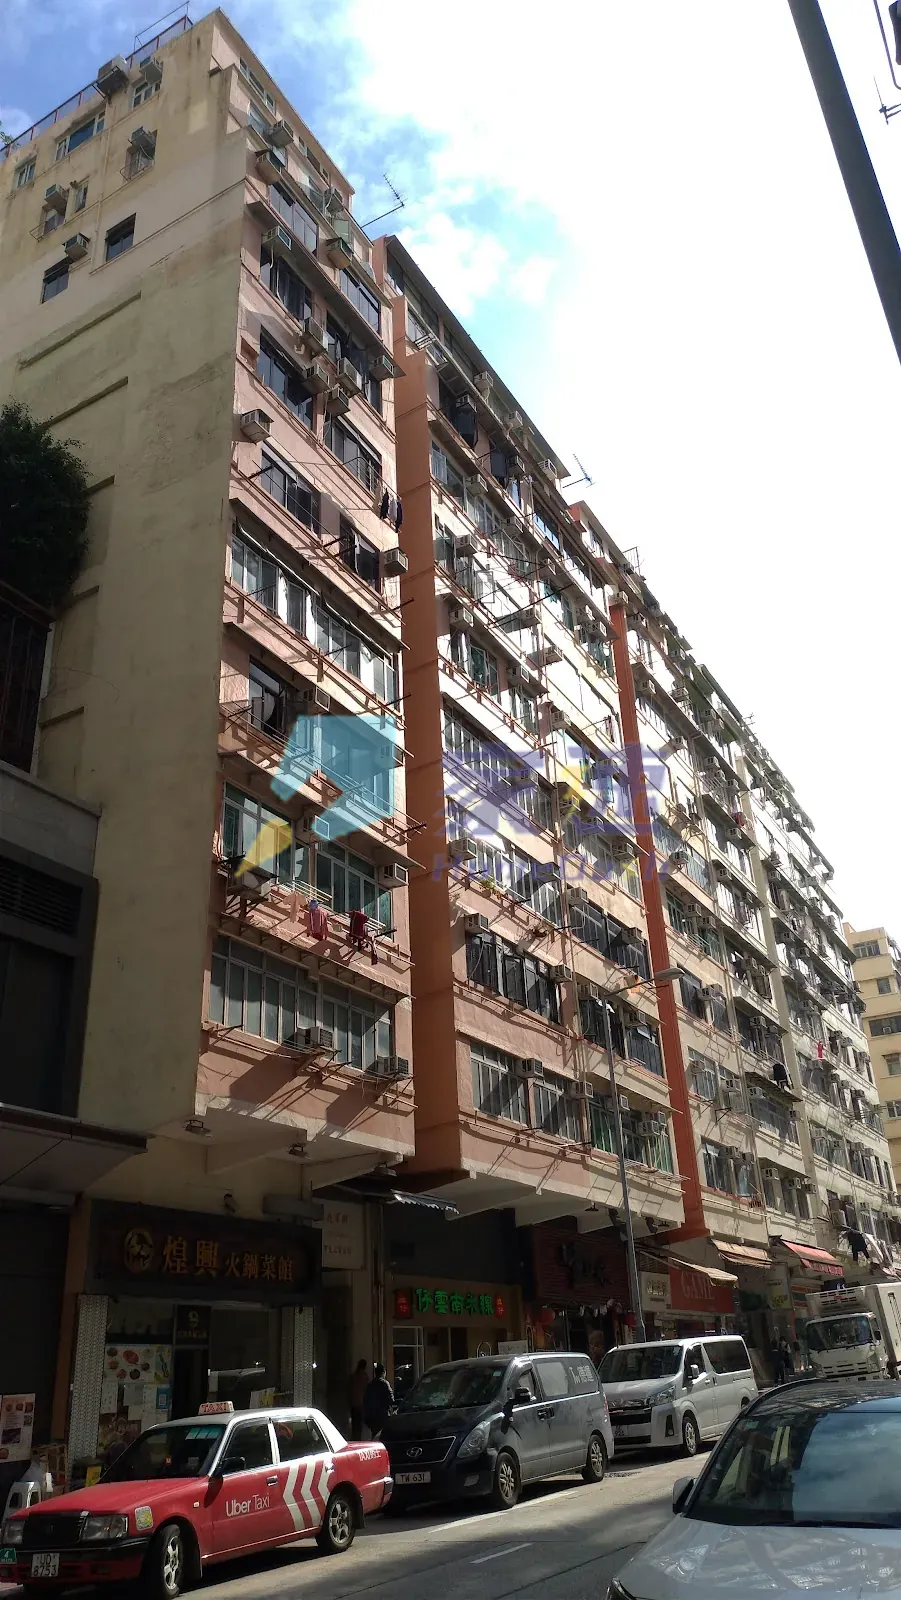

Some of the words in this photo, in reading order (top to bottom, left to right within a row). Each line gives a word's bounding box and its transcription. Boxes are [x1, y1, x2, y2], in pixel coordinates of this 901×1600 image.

[201, 1402, 227, 1413] TAXI
[400, 1474, 410, 1483] TW
[412, 1473, 425, 1482] 631
[225, 1499, 252, 1517] Uber
[252, 1493, 270, 1510] Taxi
[33, 1564, 57, 1577] 8753
